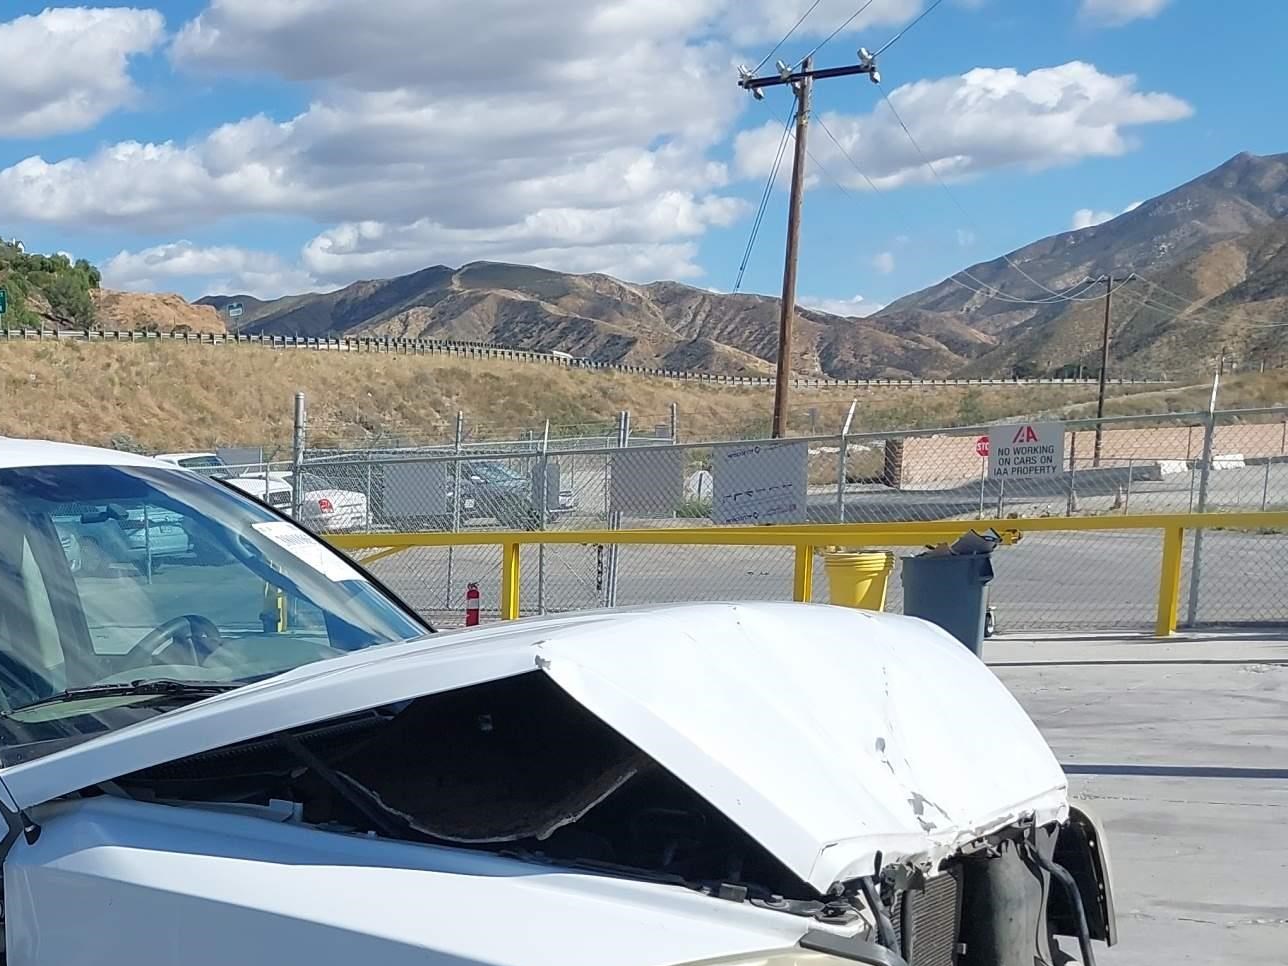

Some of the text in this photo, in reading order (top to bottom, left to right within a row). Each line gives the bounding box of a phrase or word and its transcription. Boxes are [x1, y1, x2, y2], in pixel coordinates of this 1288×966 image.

[998, 445, 1055, 456] NO WORKING
[998, 455, 1053, 466] ON CARS ON
[994, 466, 1057, 476] IAA PROPERTY
